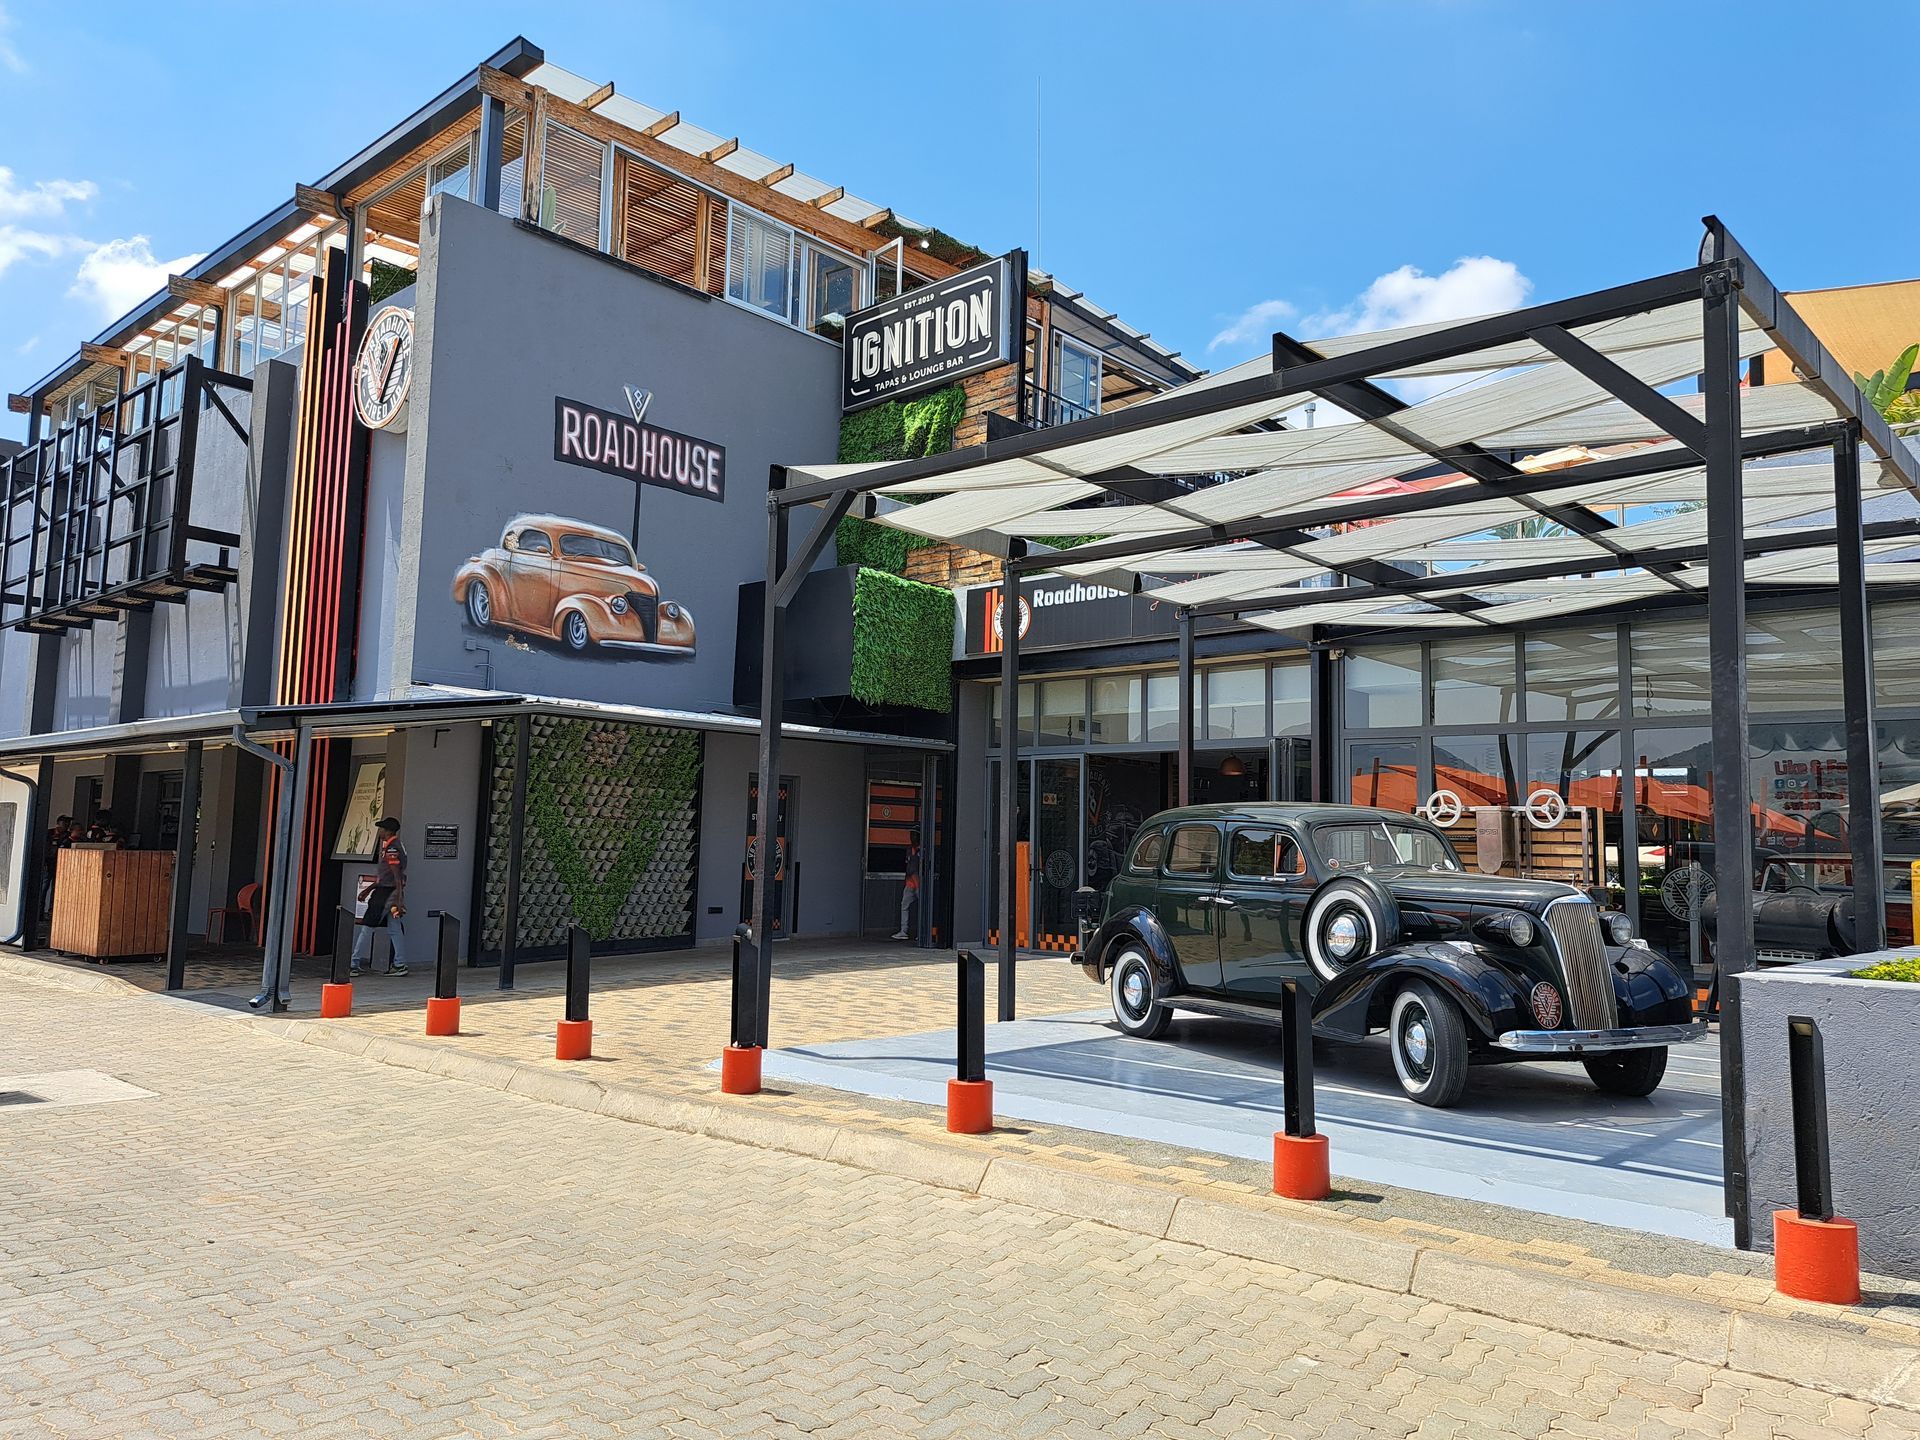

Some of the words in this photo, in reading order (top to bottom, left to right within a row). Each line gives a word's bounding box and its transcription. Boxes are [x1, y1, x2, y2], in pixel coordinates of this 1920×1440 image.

[369, 315, 412, 360] ROADHOUSE
[851, 289, 993, 383] IGNITION
[875, 376, 900, 392] TAPAS
[901, 374, 907, 384] &
[909, 362, 944, 381] LOUNGE
[946, 355, 964, 368] BAR
[364, 399, 388, 421] FIRED
[390, 386, 402, 409] UP
[561, 405, 721, 495] ROADHOUSE
[1774, 759, 1808, 775] Like
[1664, 882, 1673, 893] V8
[1670, 904, 1691, 918] FIRE
